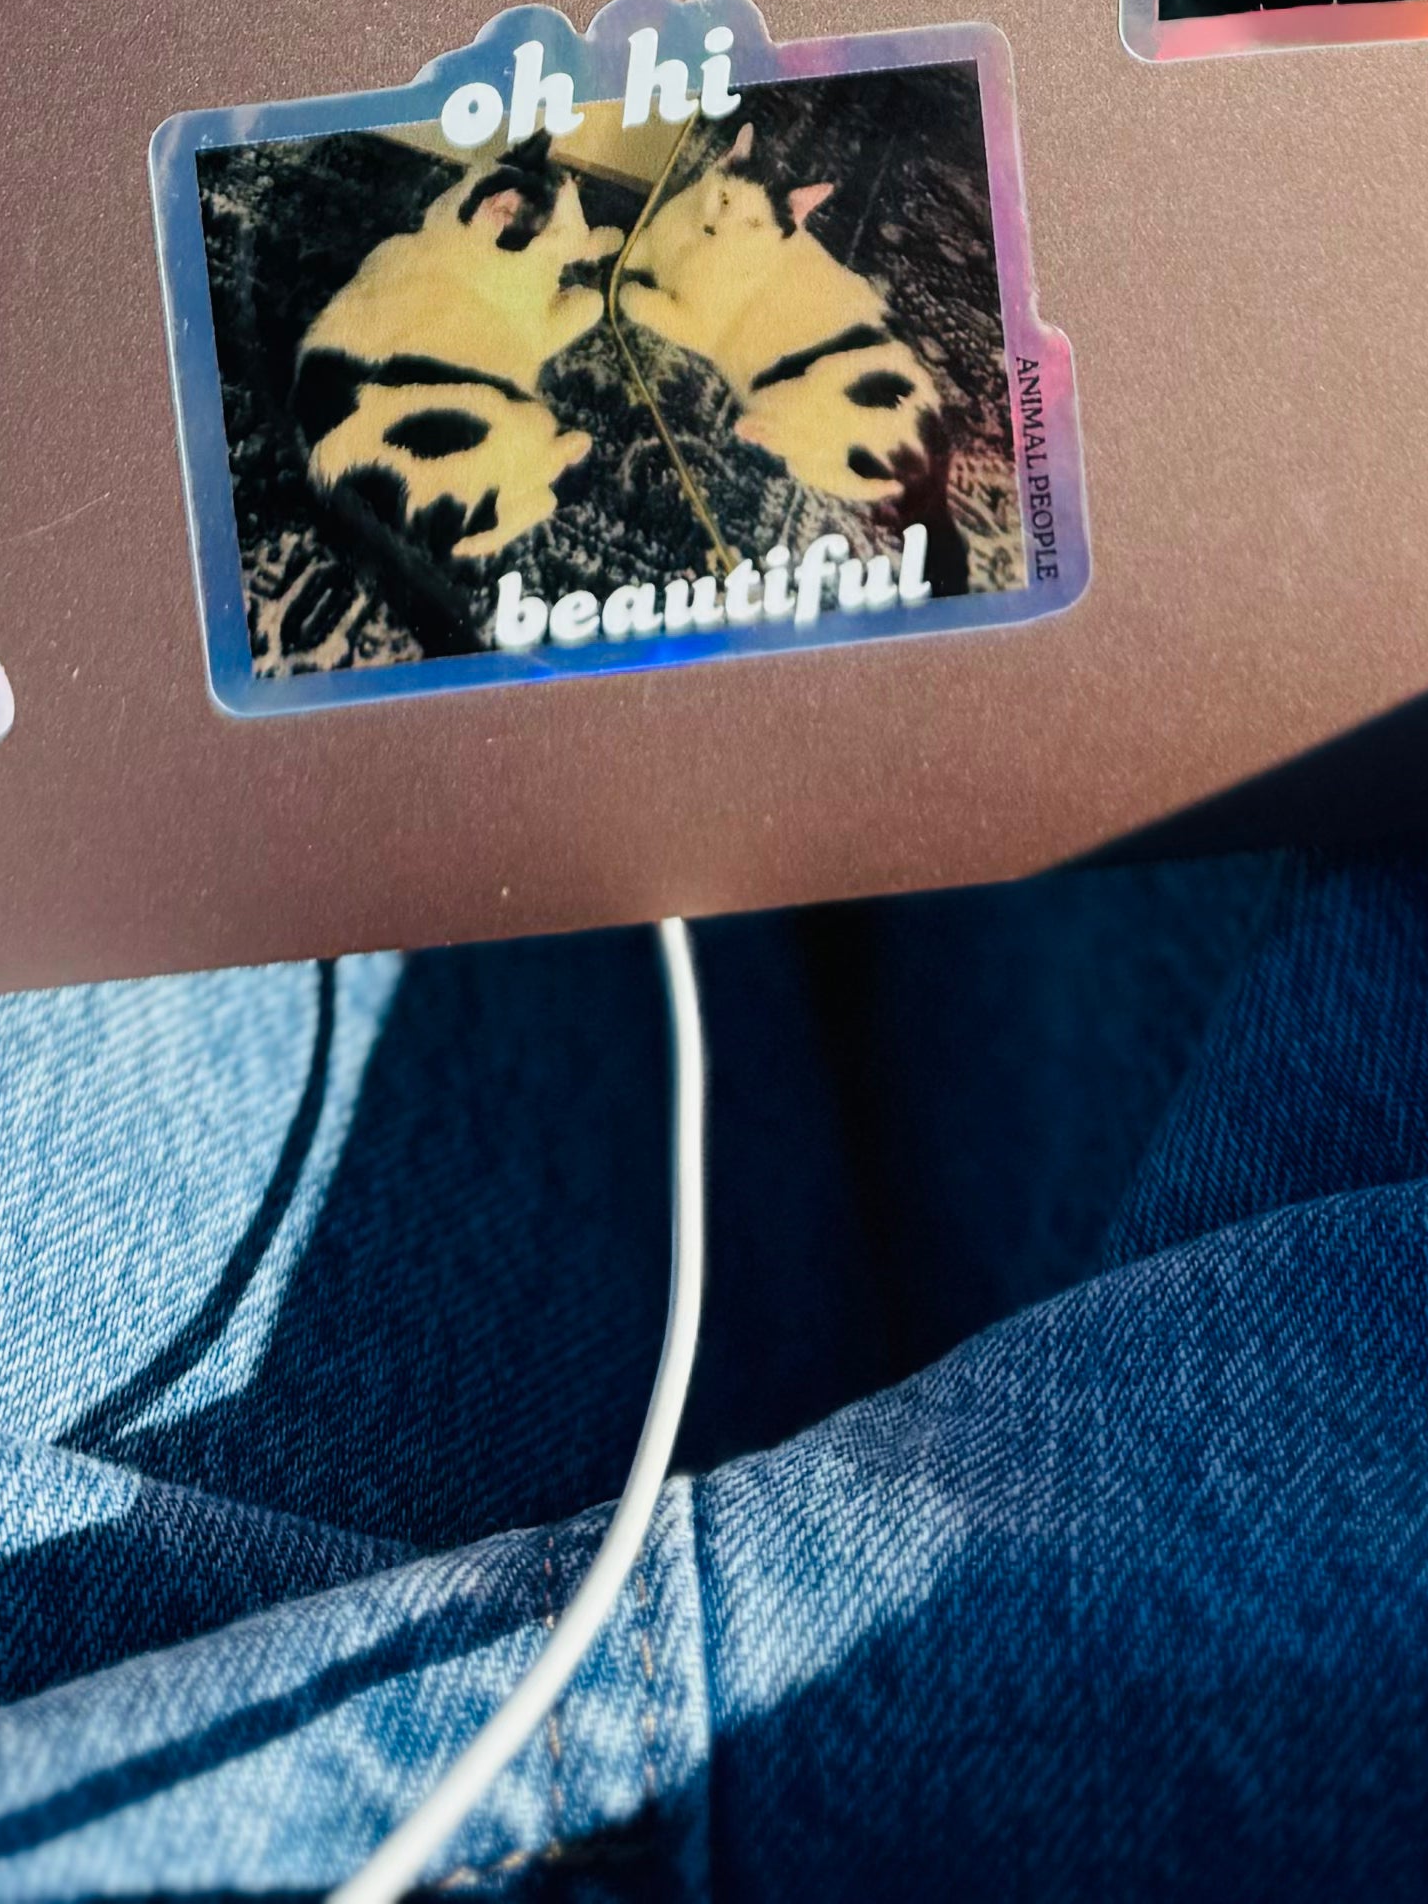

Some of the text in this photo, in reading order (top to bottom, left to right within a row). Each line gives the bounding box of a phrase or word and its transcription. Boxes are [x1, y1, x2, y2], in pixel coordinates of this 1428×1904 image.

[439, 25, 743, 149] oh hi
[1015, 356, 1060, 582] ANIMAL PEOPLE
[494, 523, 932, 652] beautiful
